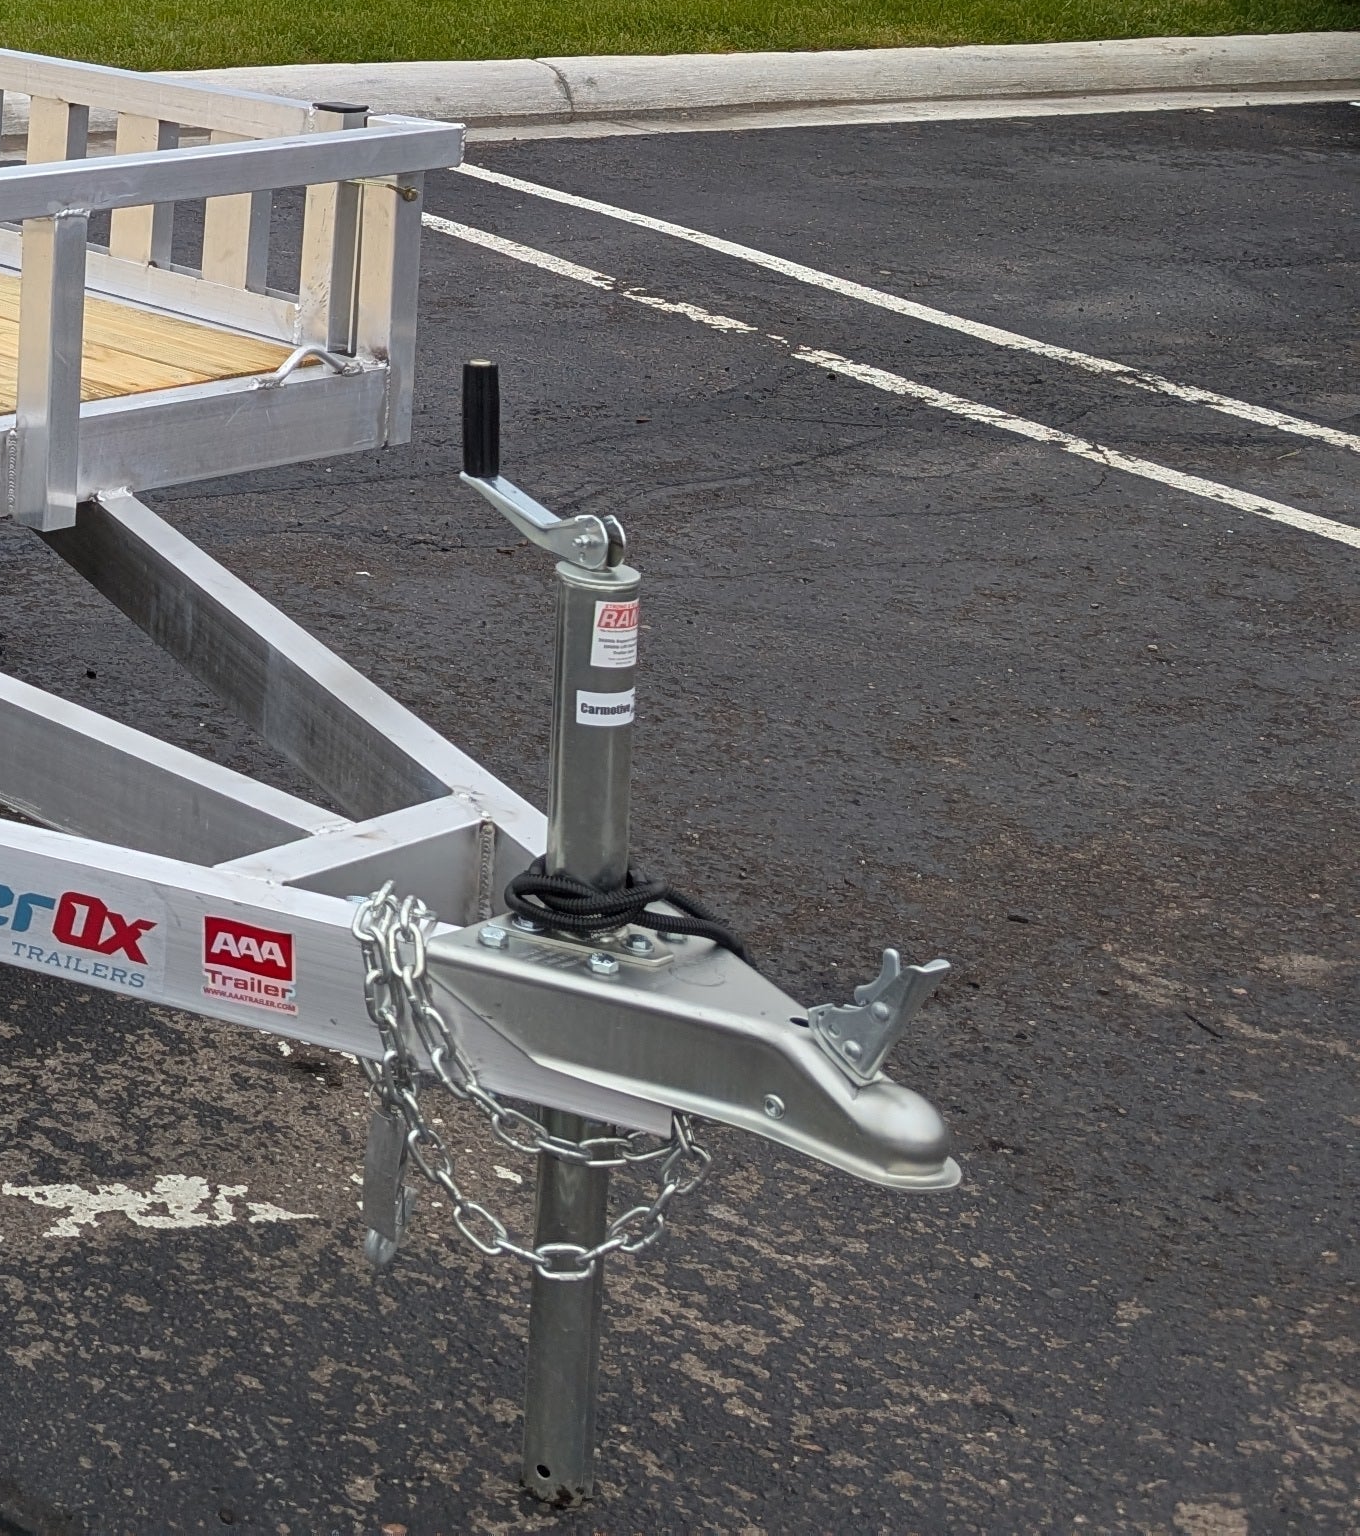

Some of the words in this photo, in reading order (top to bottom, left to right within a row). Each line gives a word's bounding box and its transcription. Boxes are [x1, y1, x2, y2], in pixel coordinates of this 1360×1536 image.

[12, 941, 145, 989] TRAILERS
[210, 931, 287, 968] AAA
[203, 986, 296, 1012] WWW.AAATRAILER.COM
[204, 968, 293, 999] Trailer
